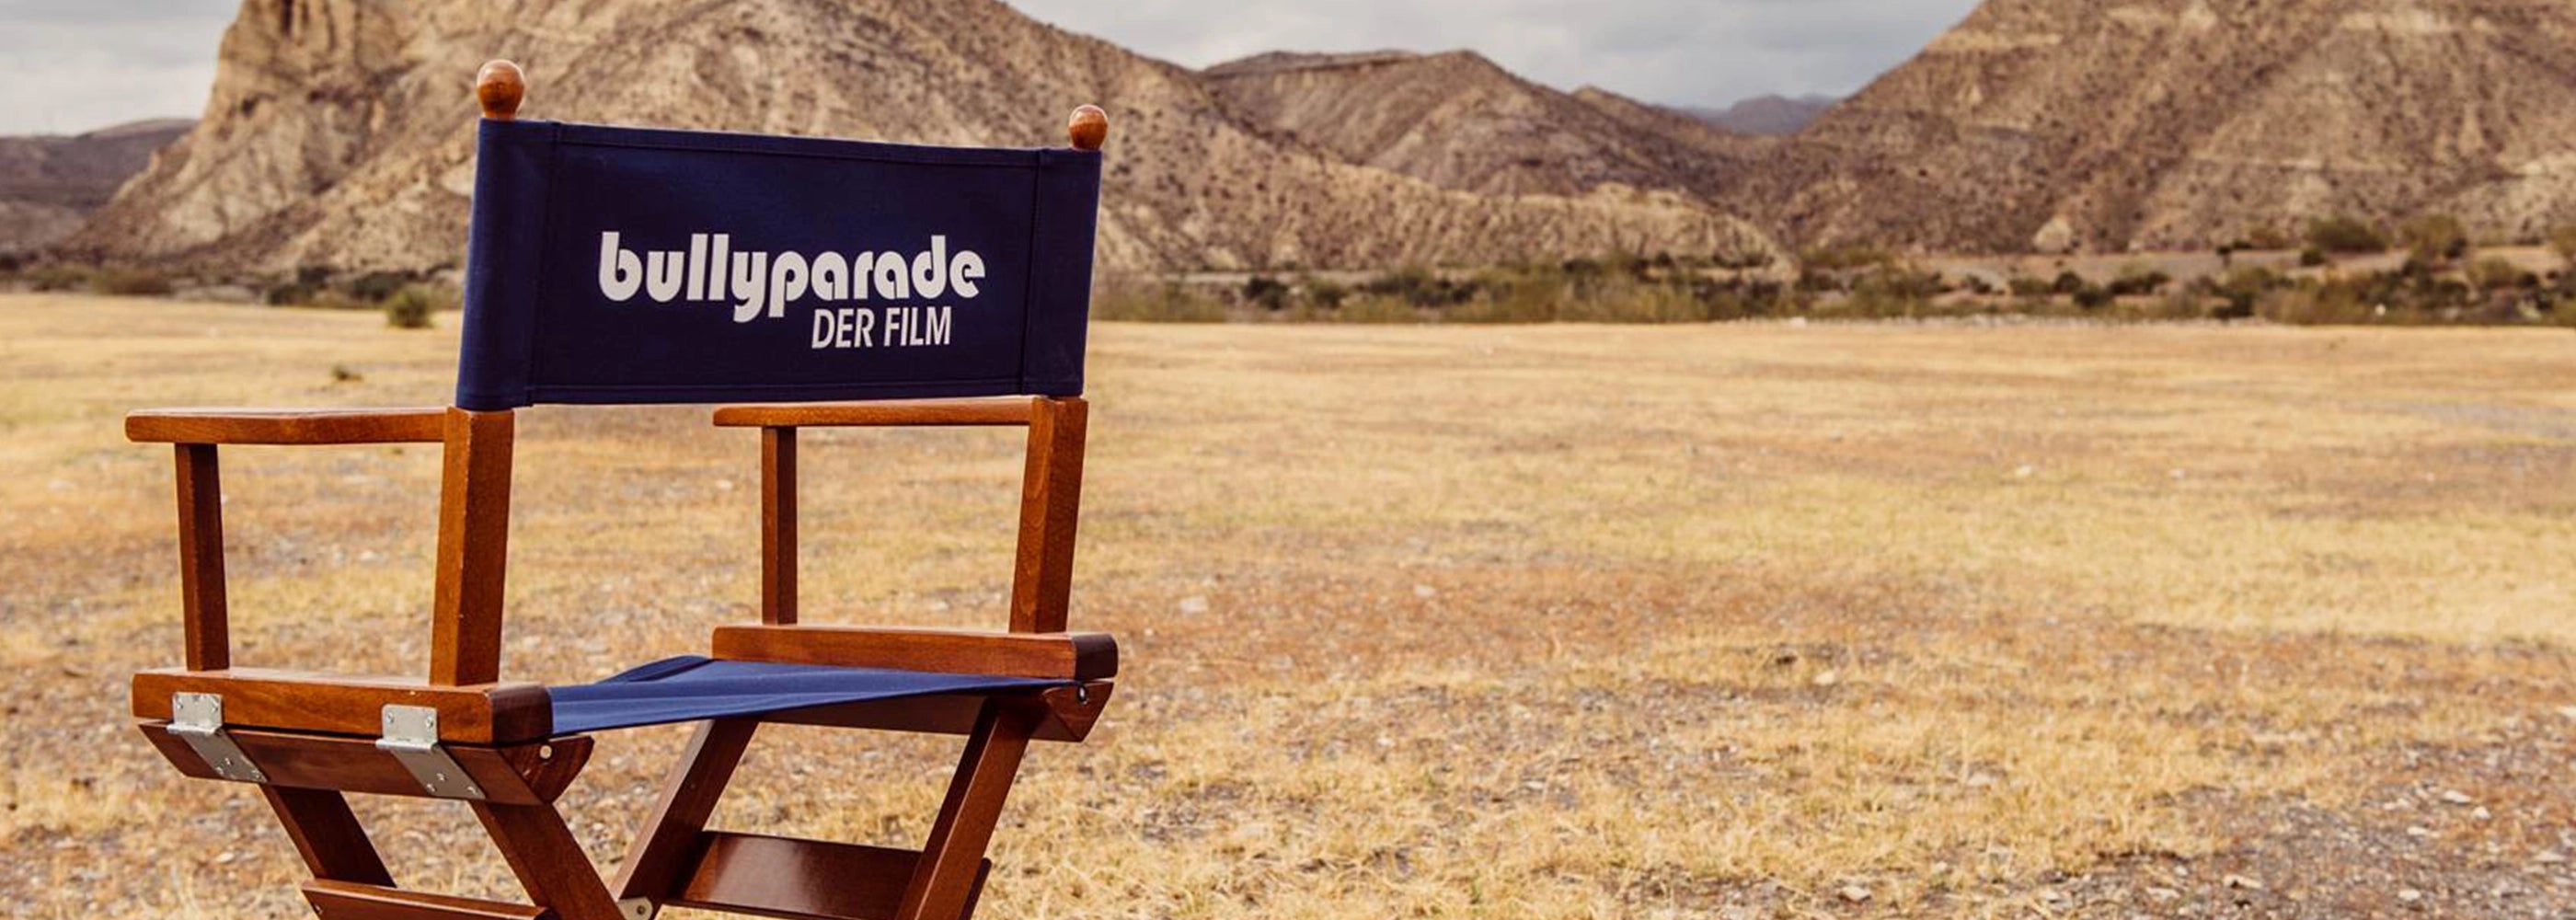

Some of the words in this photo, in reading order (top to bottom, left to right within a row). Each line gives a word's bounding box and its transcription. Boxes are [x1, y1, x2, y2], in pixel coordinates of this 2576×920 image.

[598, 231, 985, 323] bullyparade
[811, 307, 875, 350] DER
[883, 305, 952, 347] FILM
